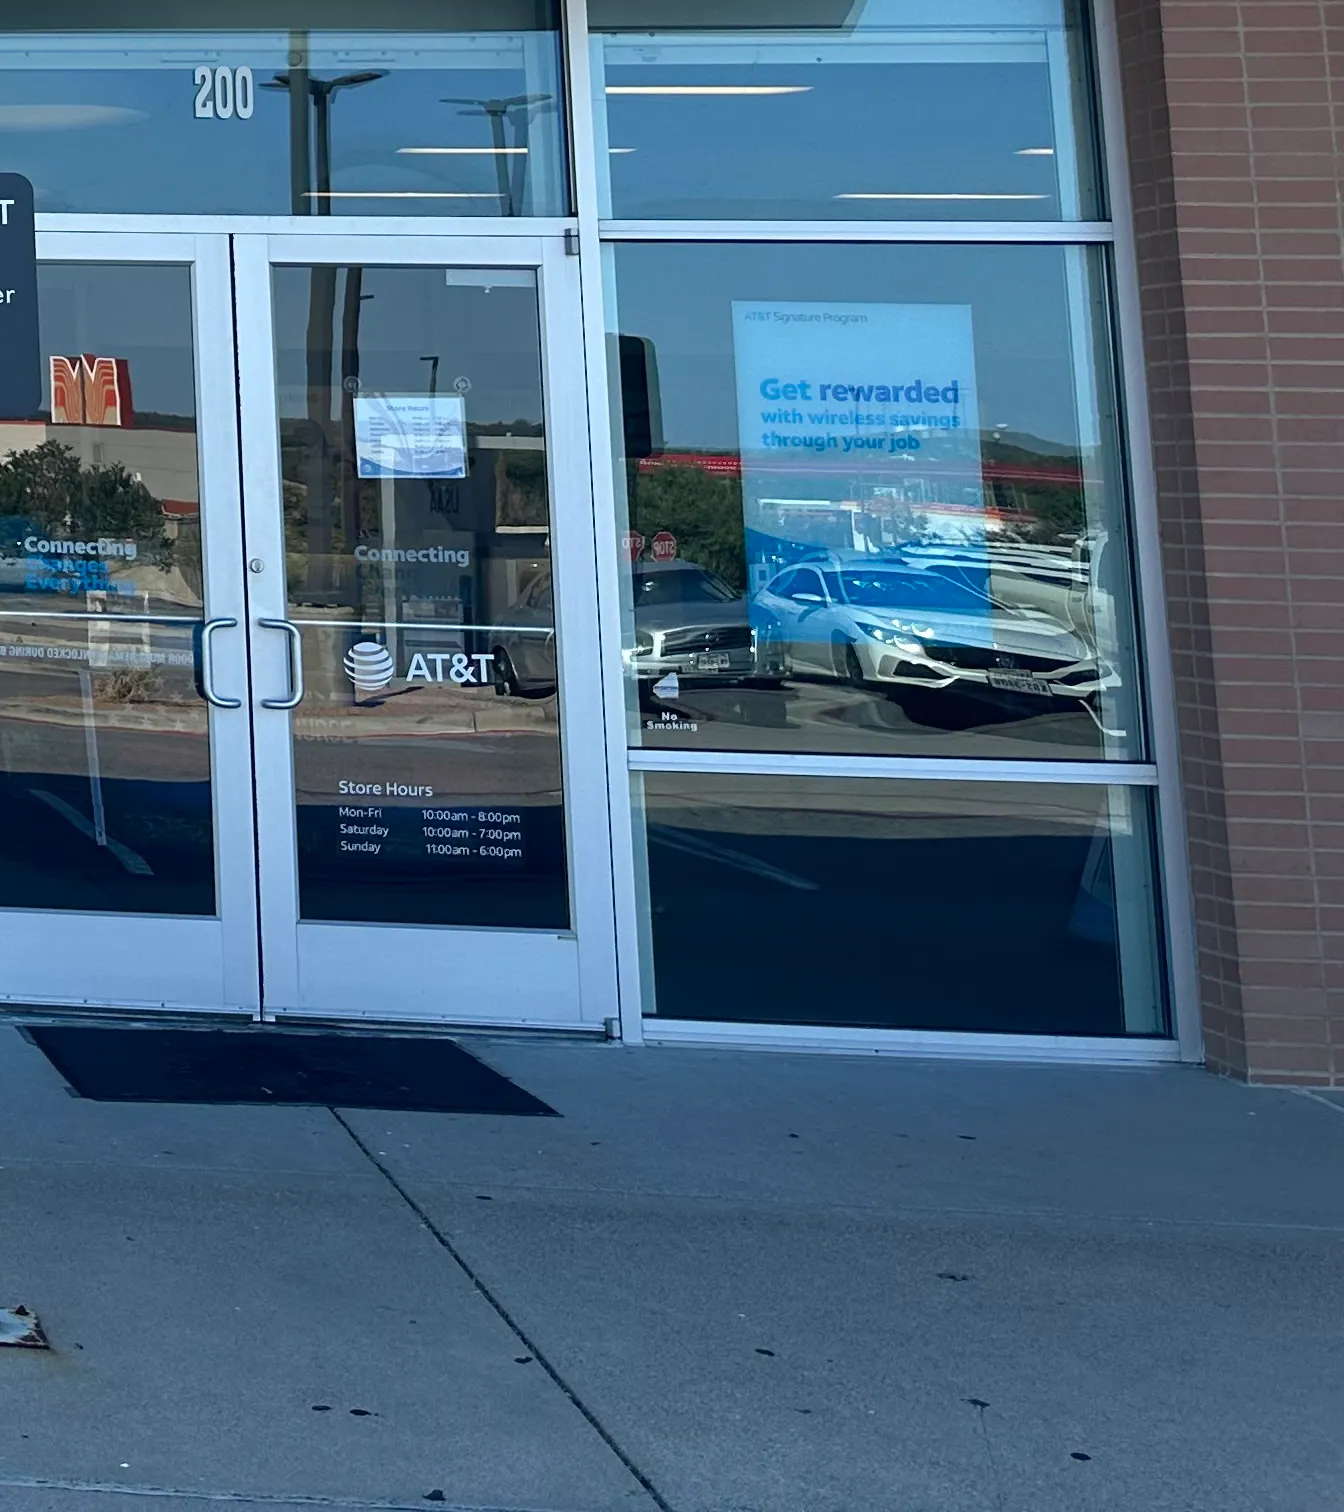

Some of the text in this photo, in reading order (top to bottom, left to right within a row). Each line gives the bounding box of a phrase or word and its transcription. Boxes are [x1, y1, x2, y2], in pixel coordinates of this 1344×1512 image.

[194, 65, 254, 119] 200
[744, 311, 867, 325] AT&T Signature Program
[760, 378, 959, 404] Get rewarded
[761, 409, 960, 430] with wireless savings
[762, 433, 920, 453] through your job
[24, 536, 137, 561] Connecting
[354, 544, 470, 568] Connecting
[406, 653, 494, 683] AT&T
[661, 711, 678, 721] No
[646, 721, 698, 732] Smoking
[339, 780, 433, 797] Store Hours
[339, 806, 382, 819] Mon-Fri
[421, 809, 468, 822] 10:00am
[478, 811, 520, 824] 8:00pm
[340, 824, 389, 838] Saturday
[422, 826, 469, 839] 10:00am
[479, 829, 521, 842] 7:00pm
[340, 841, 381, 854] Sunday
[425, 844, 470, 857] 11:00am
[479, 845, 522, 859] 6:00pm
